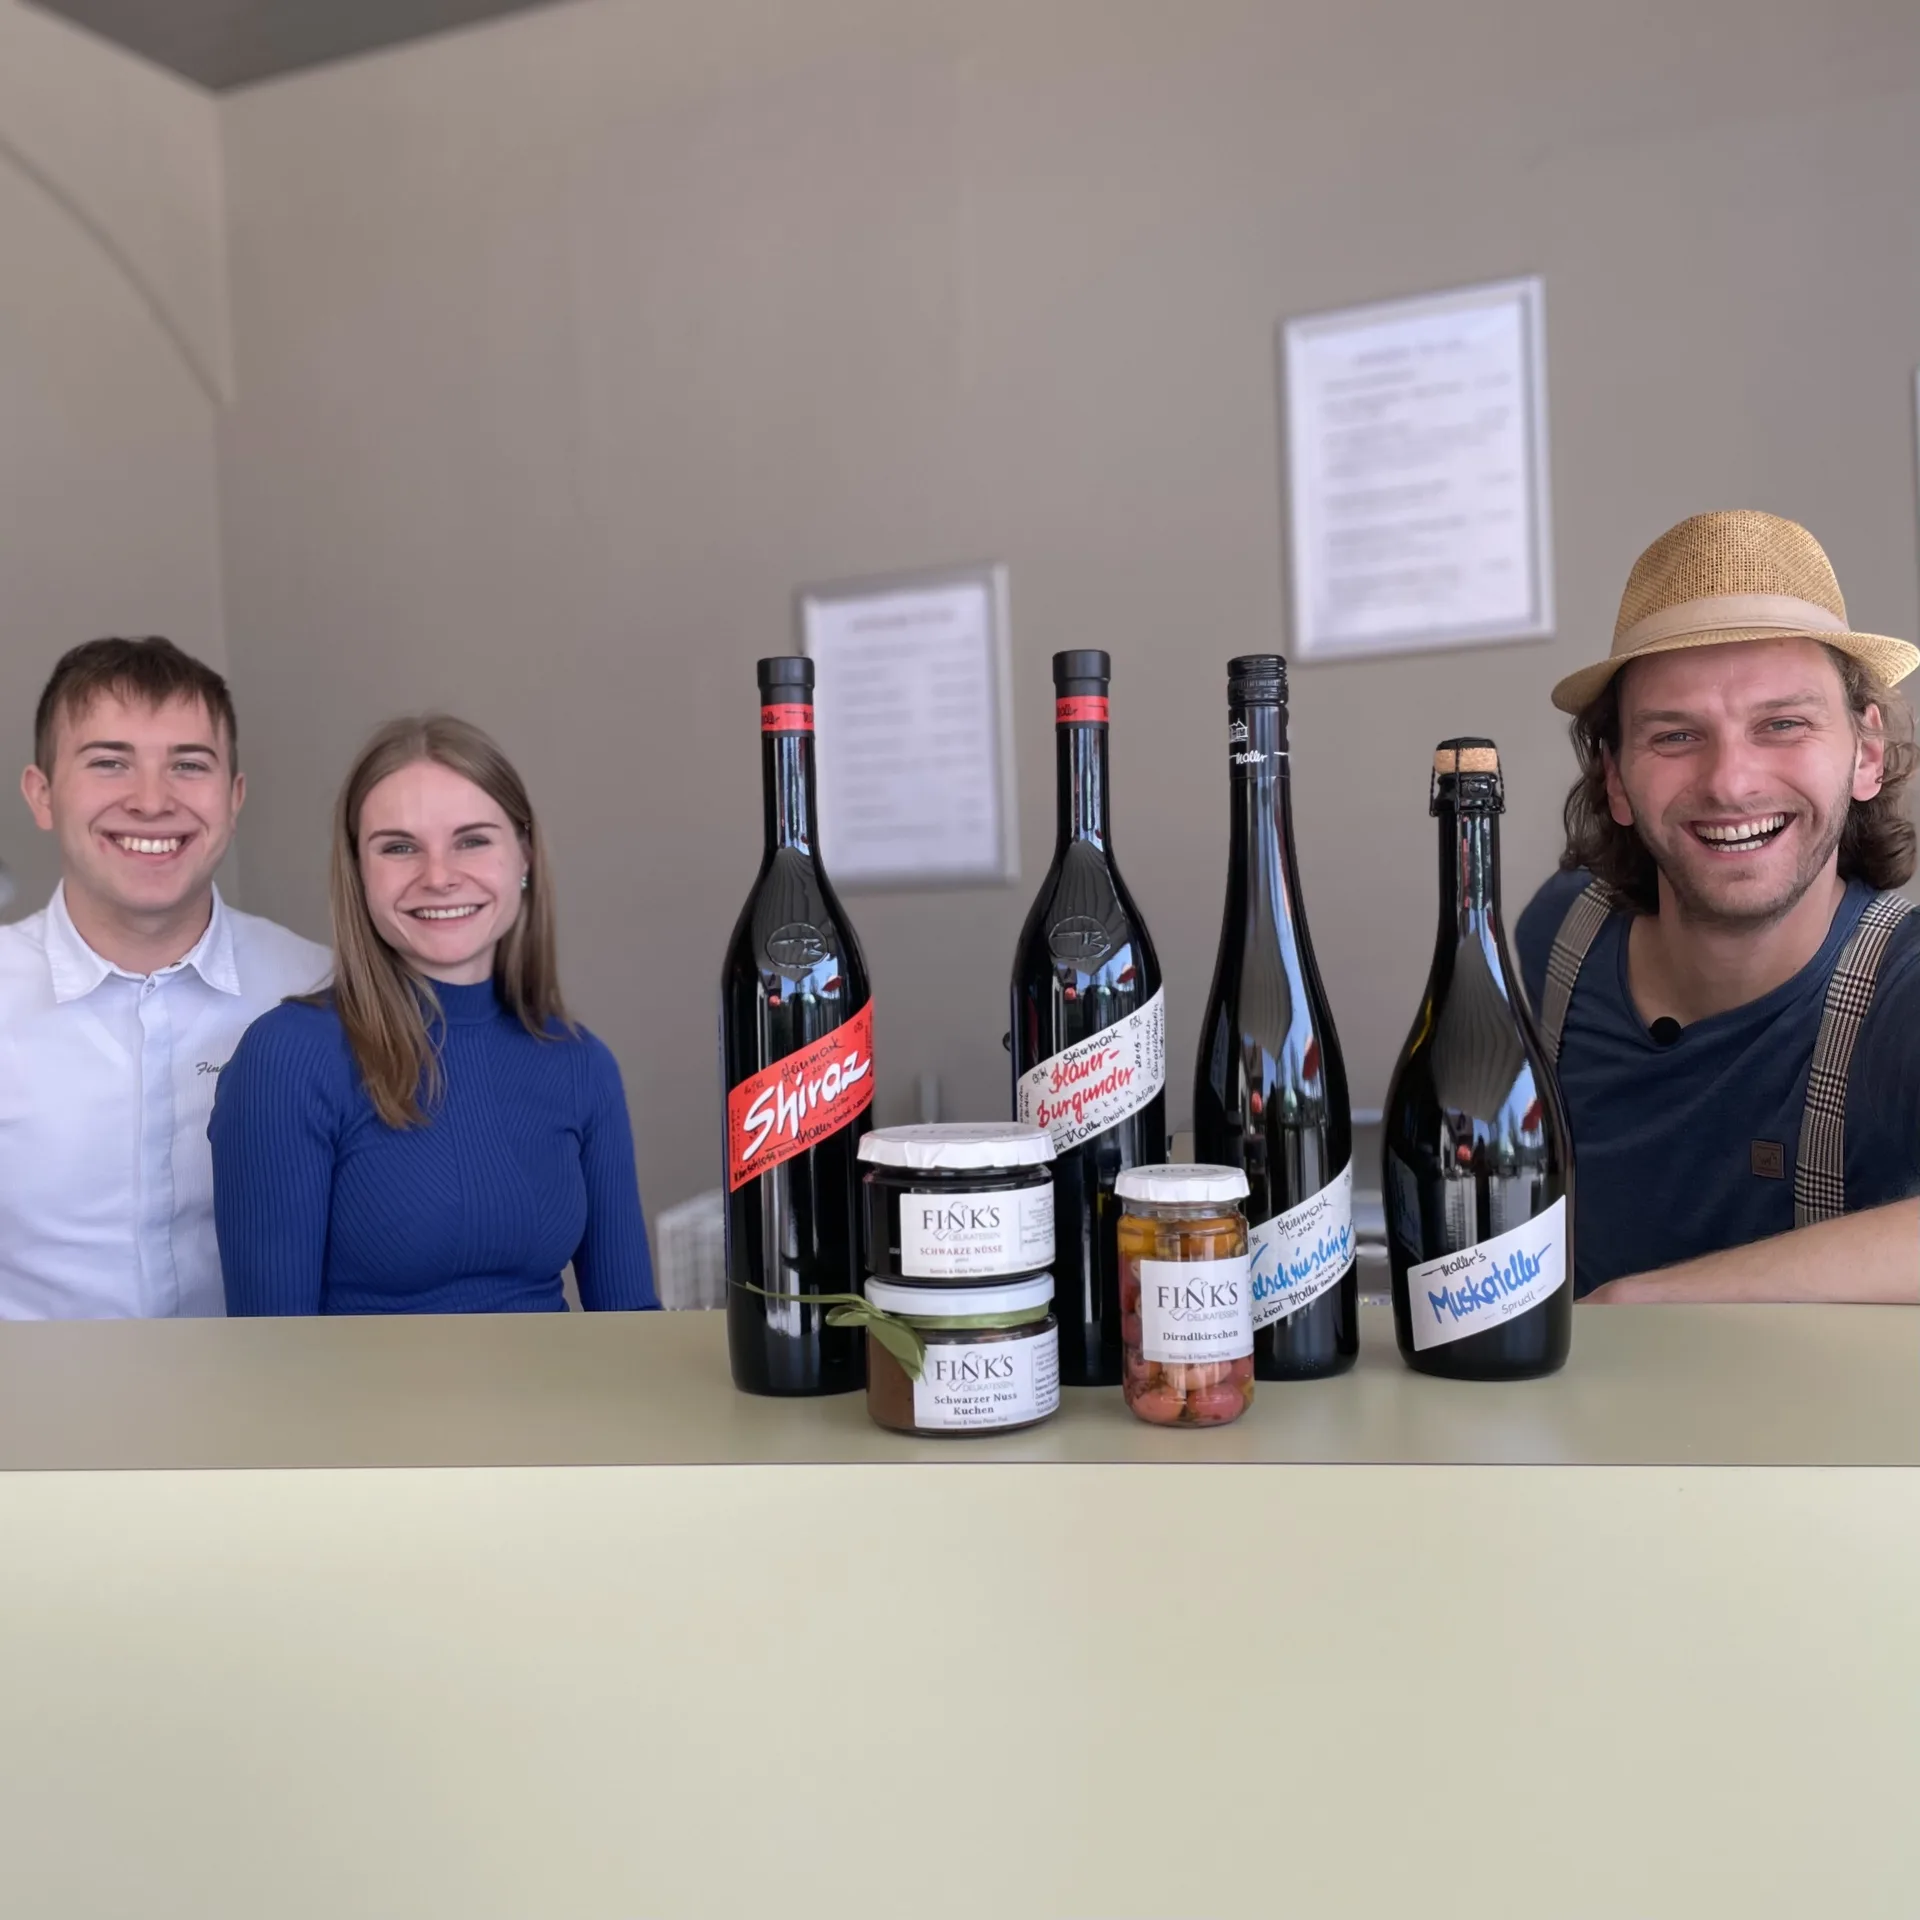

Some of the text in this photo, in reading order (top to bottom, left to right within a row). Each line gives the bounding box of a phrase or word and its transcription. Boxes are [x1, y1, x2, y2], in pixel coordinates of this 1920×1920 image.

[743, 1051, 871, 1161] Shiraz
[923, 1206, 1001, 1230] FINK'S
[920, 1244, 1003, 1256] SCHWARZE NÜSSE
[1427, 1243, 1552, 1324] Muskateller
[1157, 1281, 1239, 1309] FINK'S
[1186, 1309, 1239, 1322] DELIKATESSEN
[1163, 1329, 1239, 1342] Dirndlkirschen
[935, 1355, 1014, 1381] FINK'S
[934, 1391, 1018, 1405] Schwarzer Nuss
[953, 1405, 995, 1416] Kuchen
